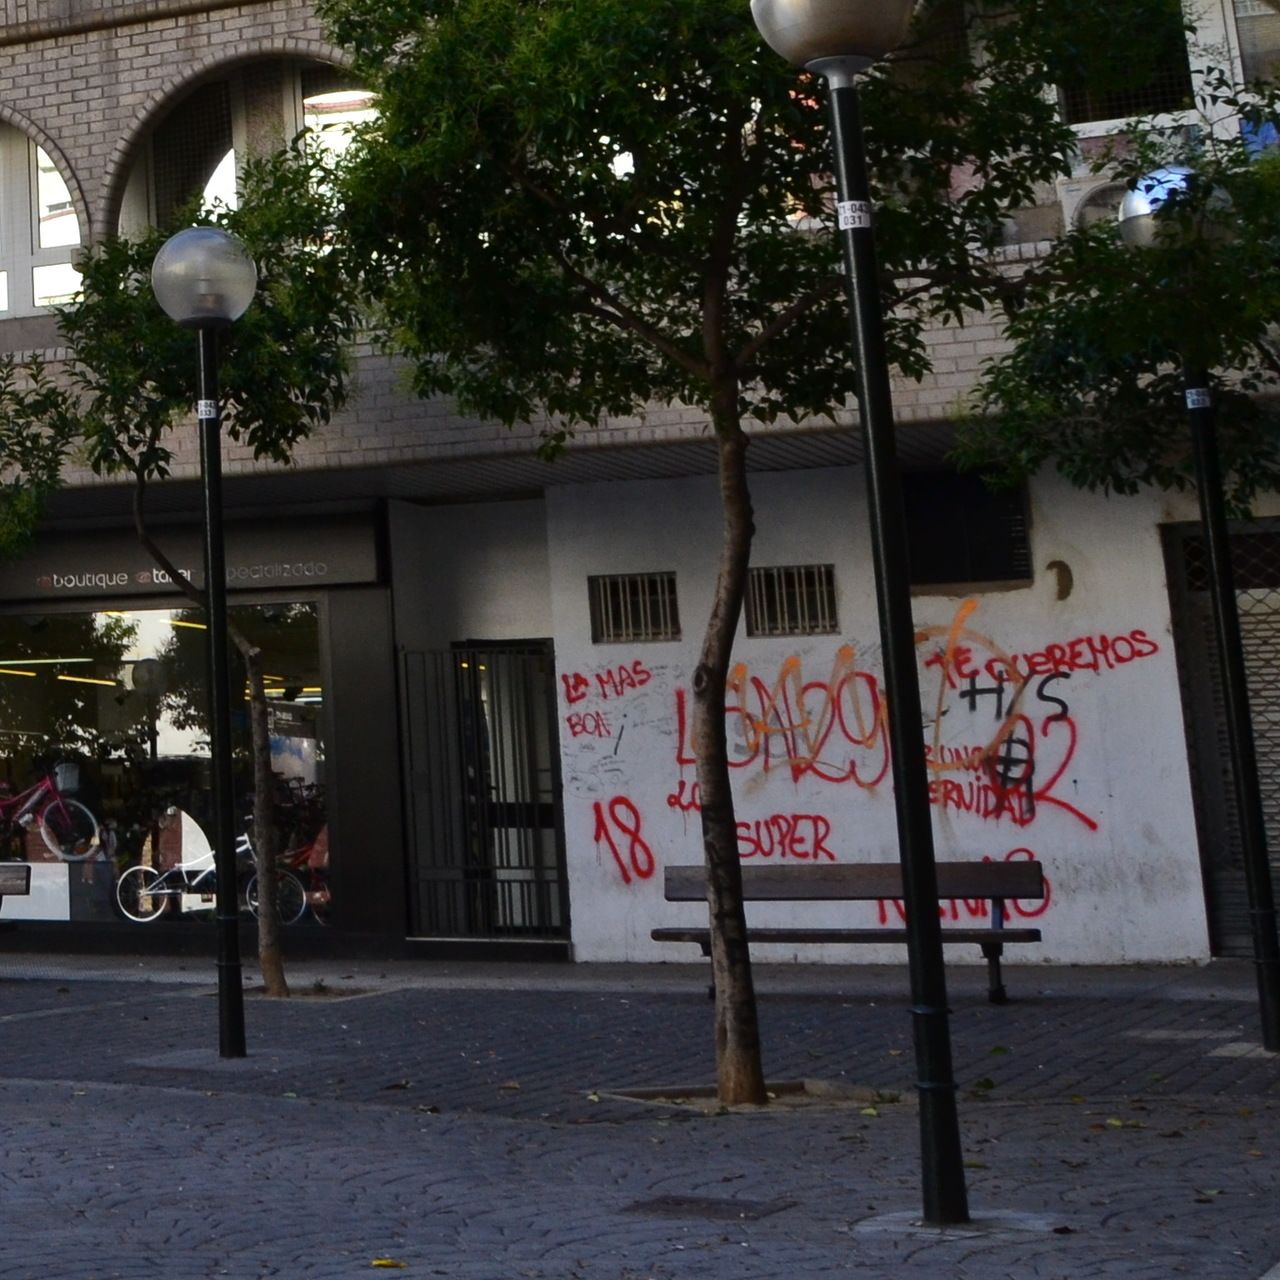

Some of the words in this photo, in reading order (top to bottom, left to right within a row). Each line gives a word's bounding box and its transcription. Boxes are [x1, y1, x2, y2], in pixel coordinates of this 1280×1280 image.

[843, 215, 863, 226] 031
[595, 660, 652, 700] MAS
[593, 795, 655, 884] 18
[736, 814, 836, 861] SUPER
